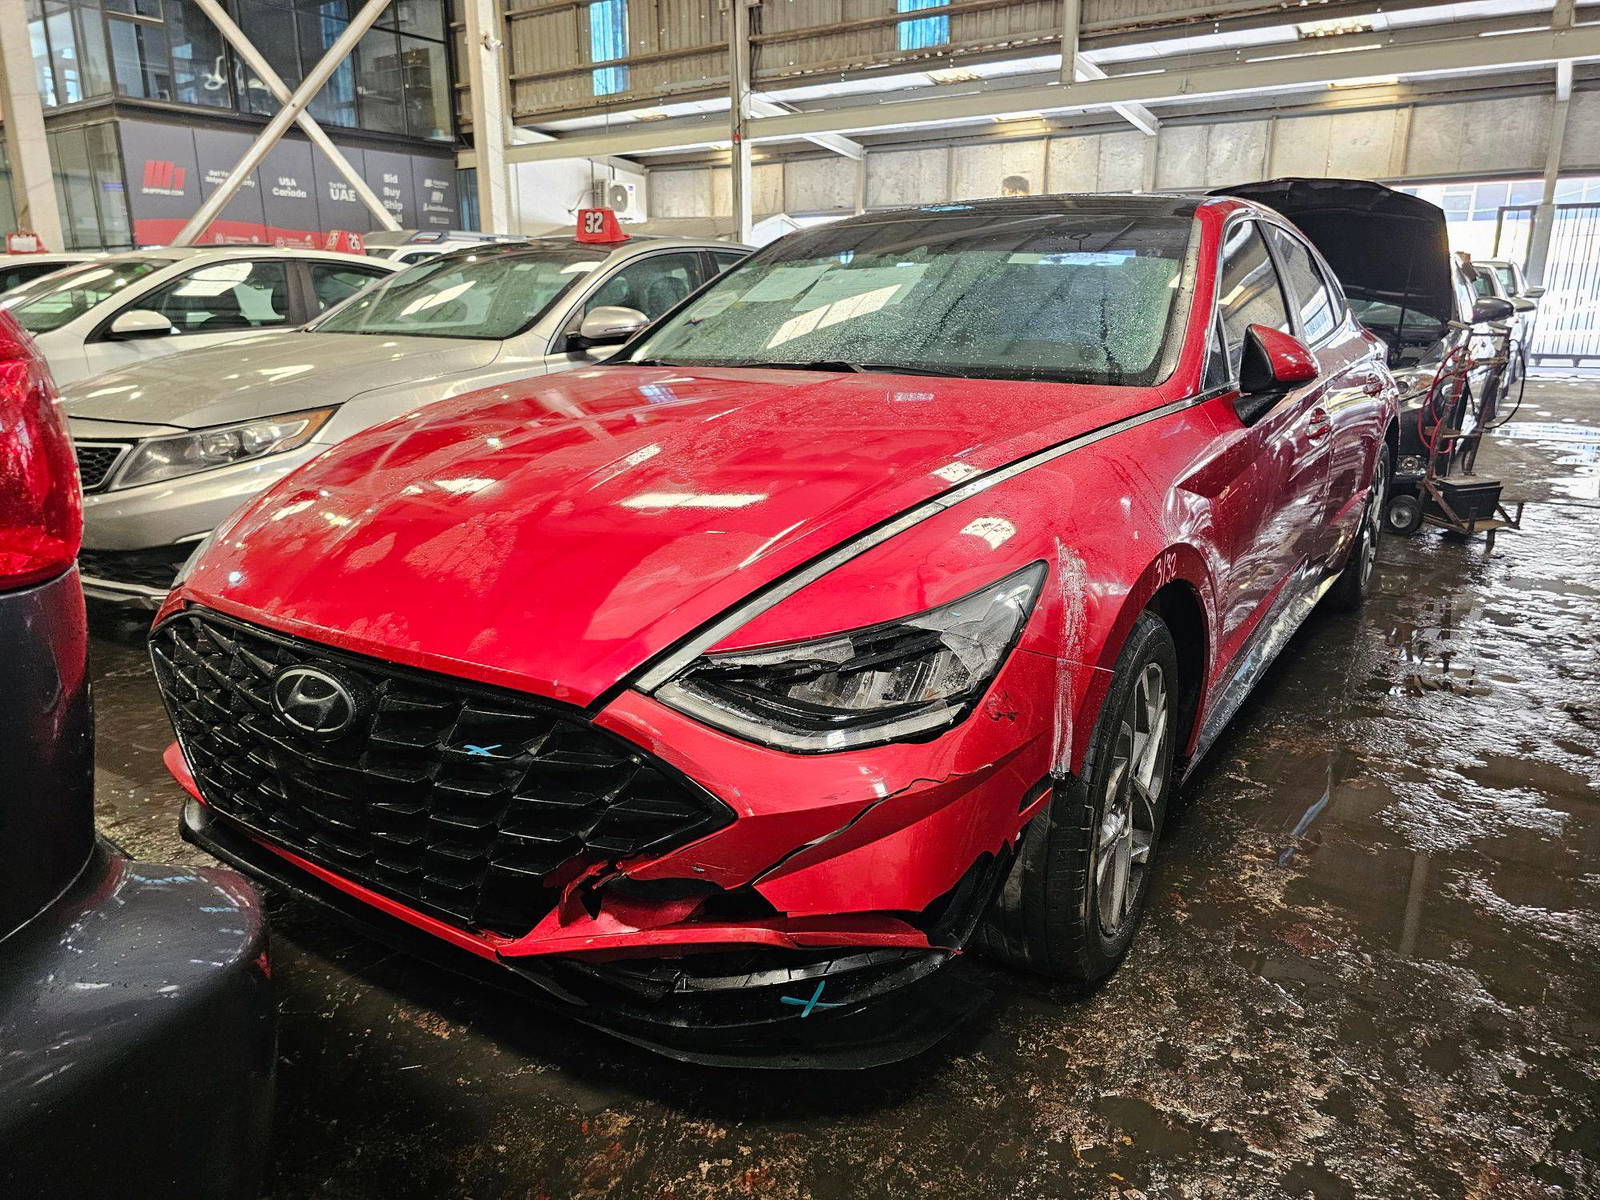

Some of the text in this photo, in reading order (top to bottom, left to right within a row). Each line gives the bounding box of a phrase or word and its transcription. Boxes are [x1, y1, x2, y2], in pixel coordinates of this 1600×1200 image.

[279, 177, 297, 187] USA
[383, 173, 398, 184] Bid
[272, 187, 307, 198] Canada
[330, 188, 357, 202] UAE
[383, 187, 401, 200] Buy
[585, 211, 603, 233] 32
